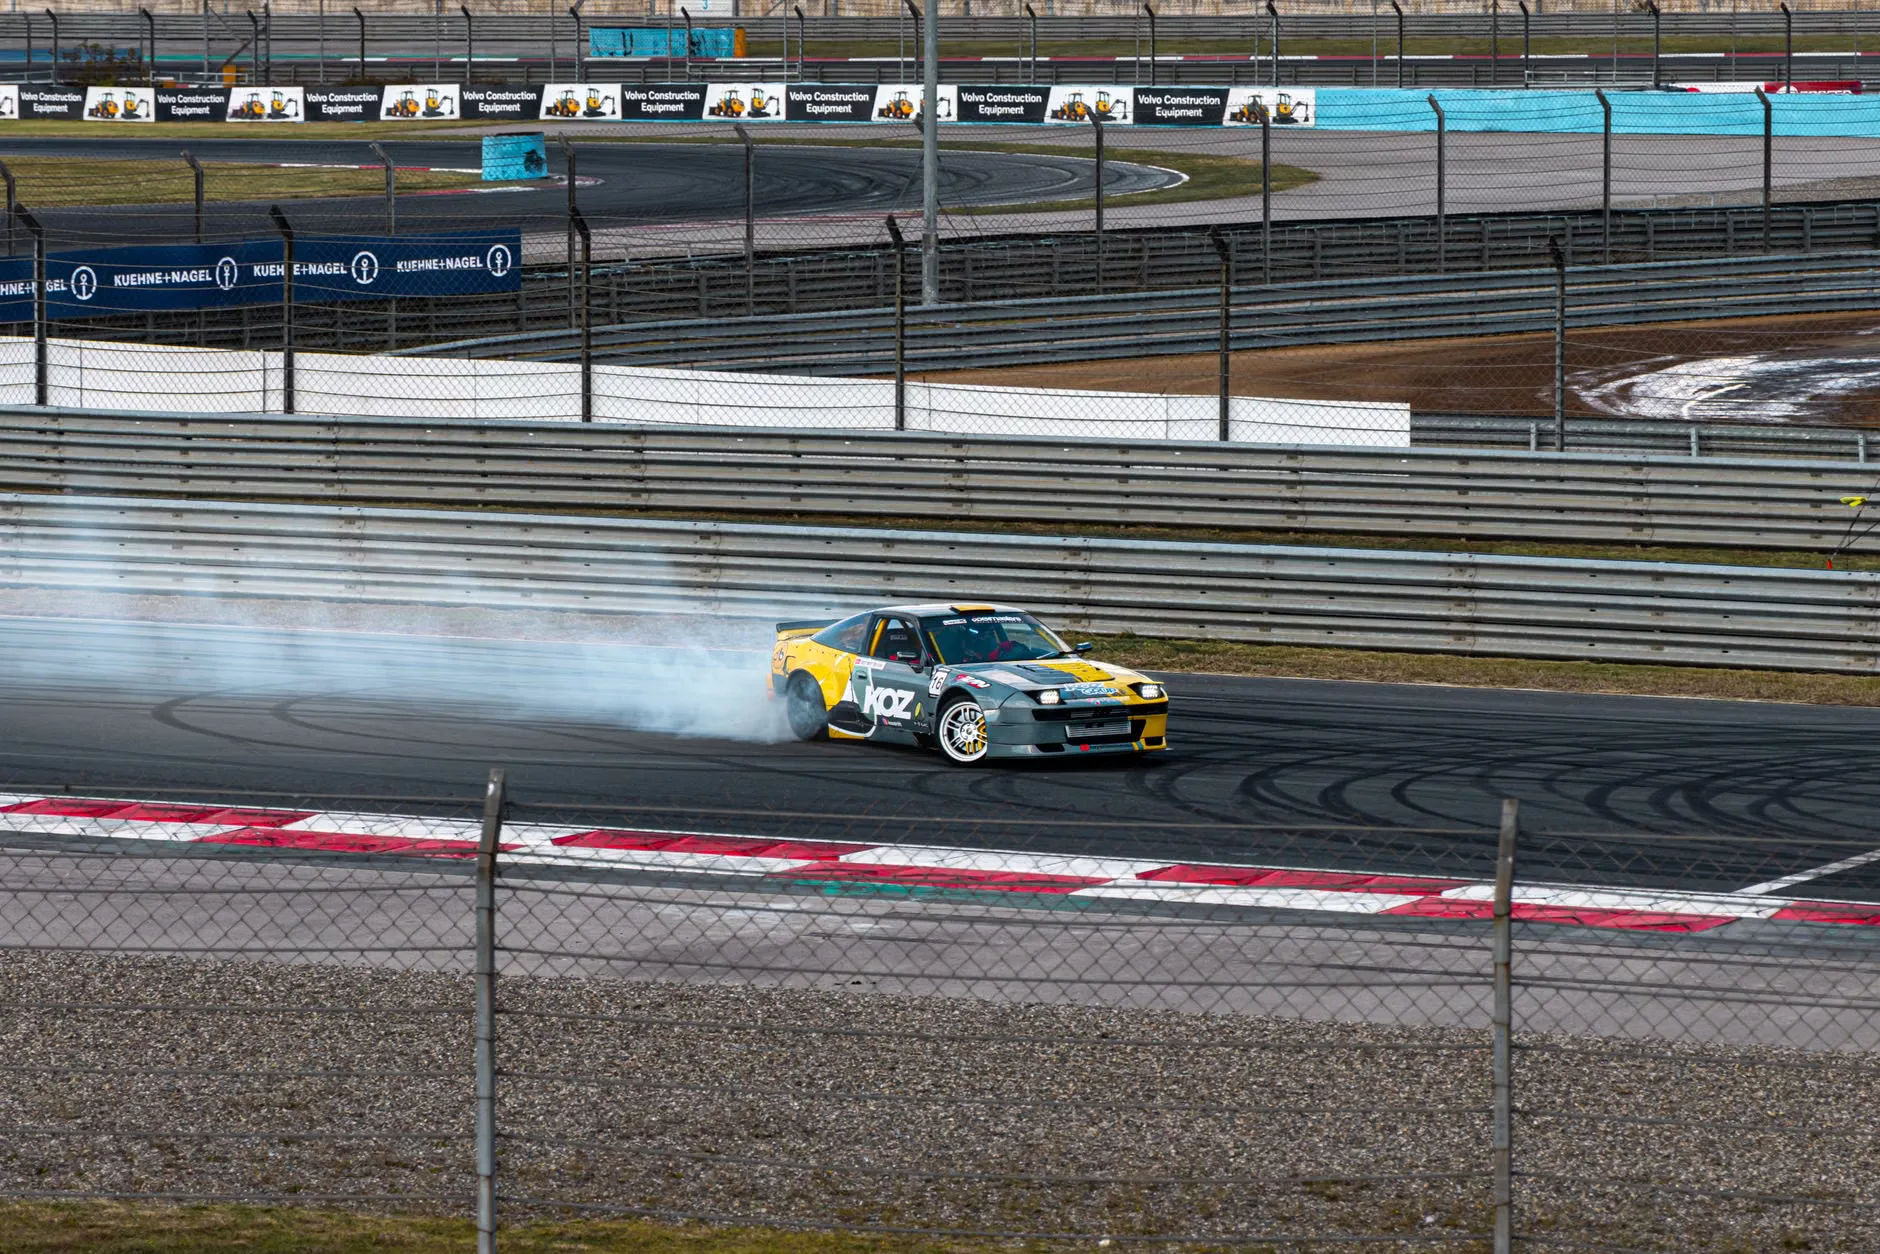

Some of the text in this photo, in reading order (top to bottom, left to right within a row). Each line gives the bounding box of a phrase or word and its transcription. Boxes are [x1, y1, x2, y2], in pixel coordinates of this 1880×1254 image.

[20, 91, 82, 102] Volvo Construction
[157, 94, 225, 104] Volvo Construction
[306, 92, 378, 102] Volvo Construction
[462, 90, 537, 100] Volvo Construction
[624, 90, 700, 100] Volvo Construction
[789, 91, 869, 101] Volvo Construction
[961, 92, 1042, 102] Volvo Construction
[1138, 94, 1221, 104] Volvo Construction
[33, 103, 69, 114] Equipment
[171, 105, 210, 115] Equipment
[321, 103, 363, 114] Equipment
[478, 102, 521, 112] Equipment
[641, 102, 684, 112] Equipment
[806, 103, 852, 113] Equipment
[978, 104, 1024, 115] Equipment
[1155, 106, 1203, 117] Equipment
[253, 262, 348, 277] KUEHE+NAGEL
[396, 256, 483, 273] KUEHNE+NAGEL
[113, 269, 212, 287] KUEHNE+NAGEL
[0, 279, 68, 296] HNE+GEL
[931, 676, 943, 690] 16
[864, 685, 915, 720] KOZ
